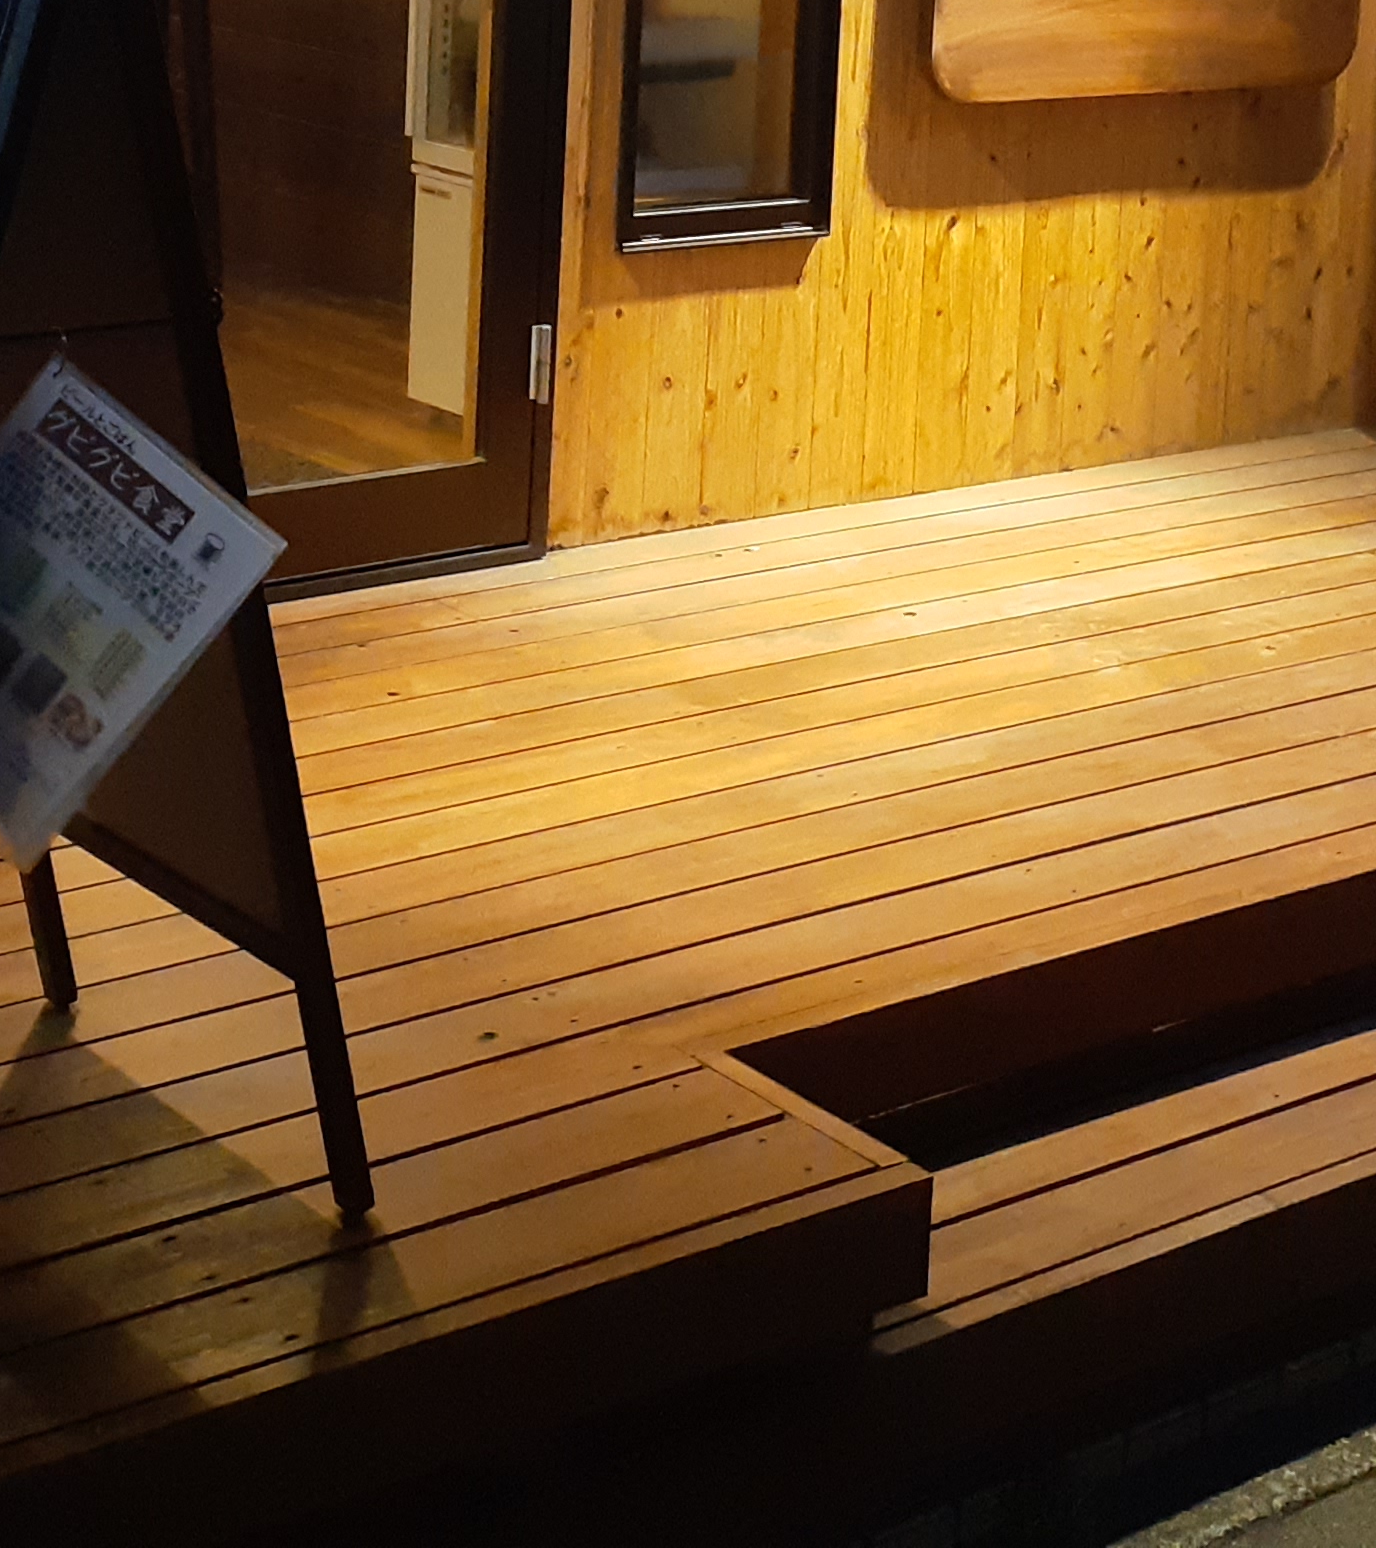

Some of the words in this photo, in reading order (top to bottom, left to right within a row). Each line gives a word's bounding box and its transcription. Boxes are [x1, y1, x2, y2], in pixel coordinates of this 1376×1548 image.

[46, 409, 190, 538] グビグビ食堂
